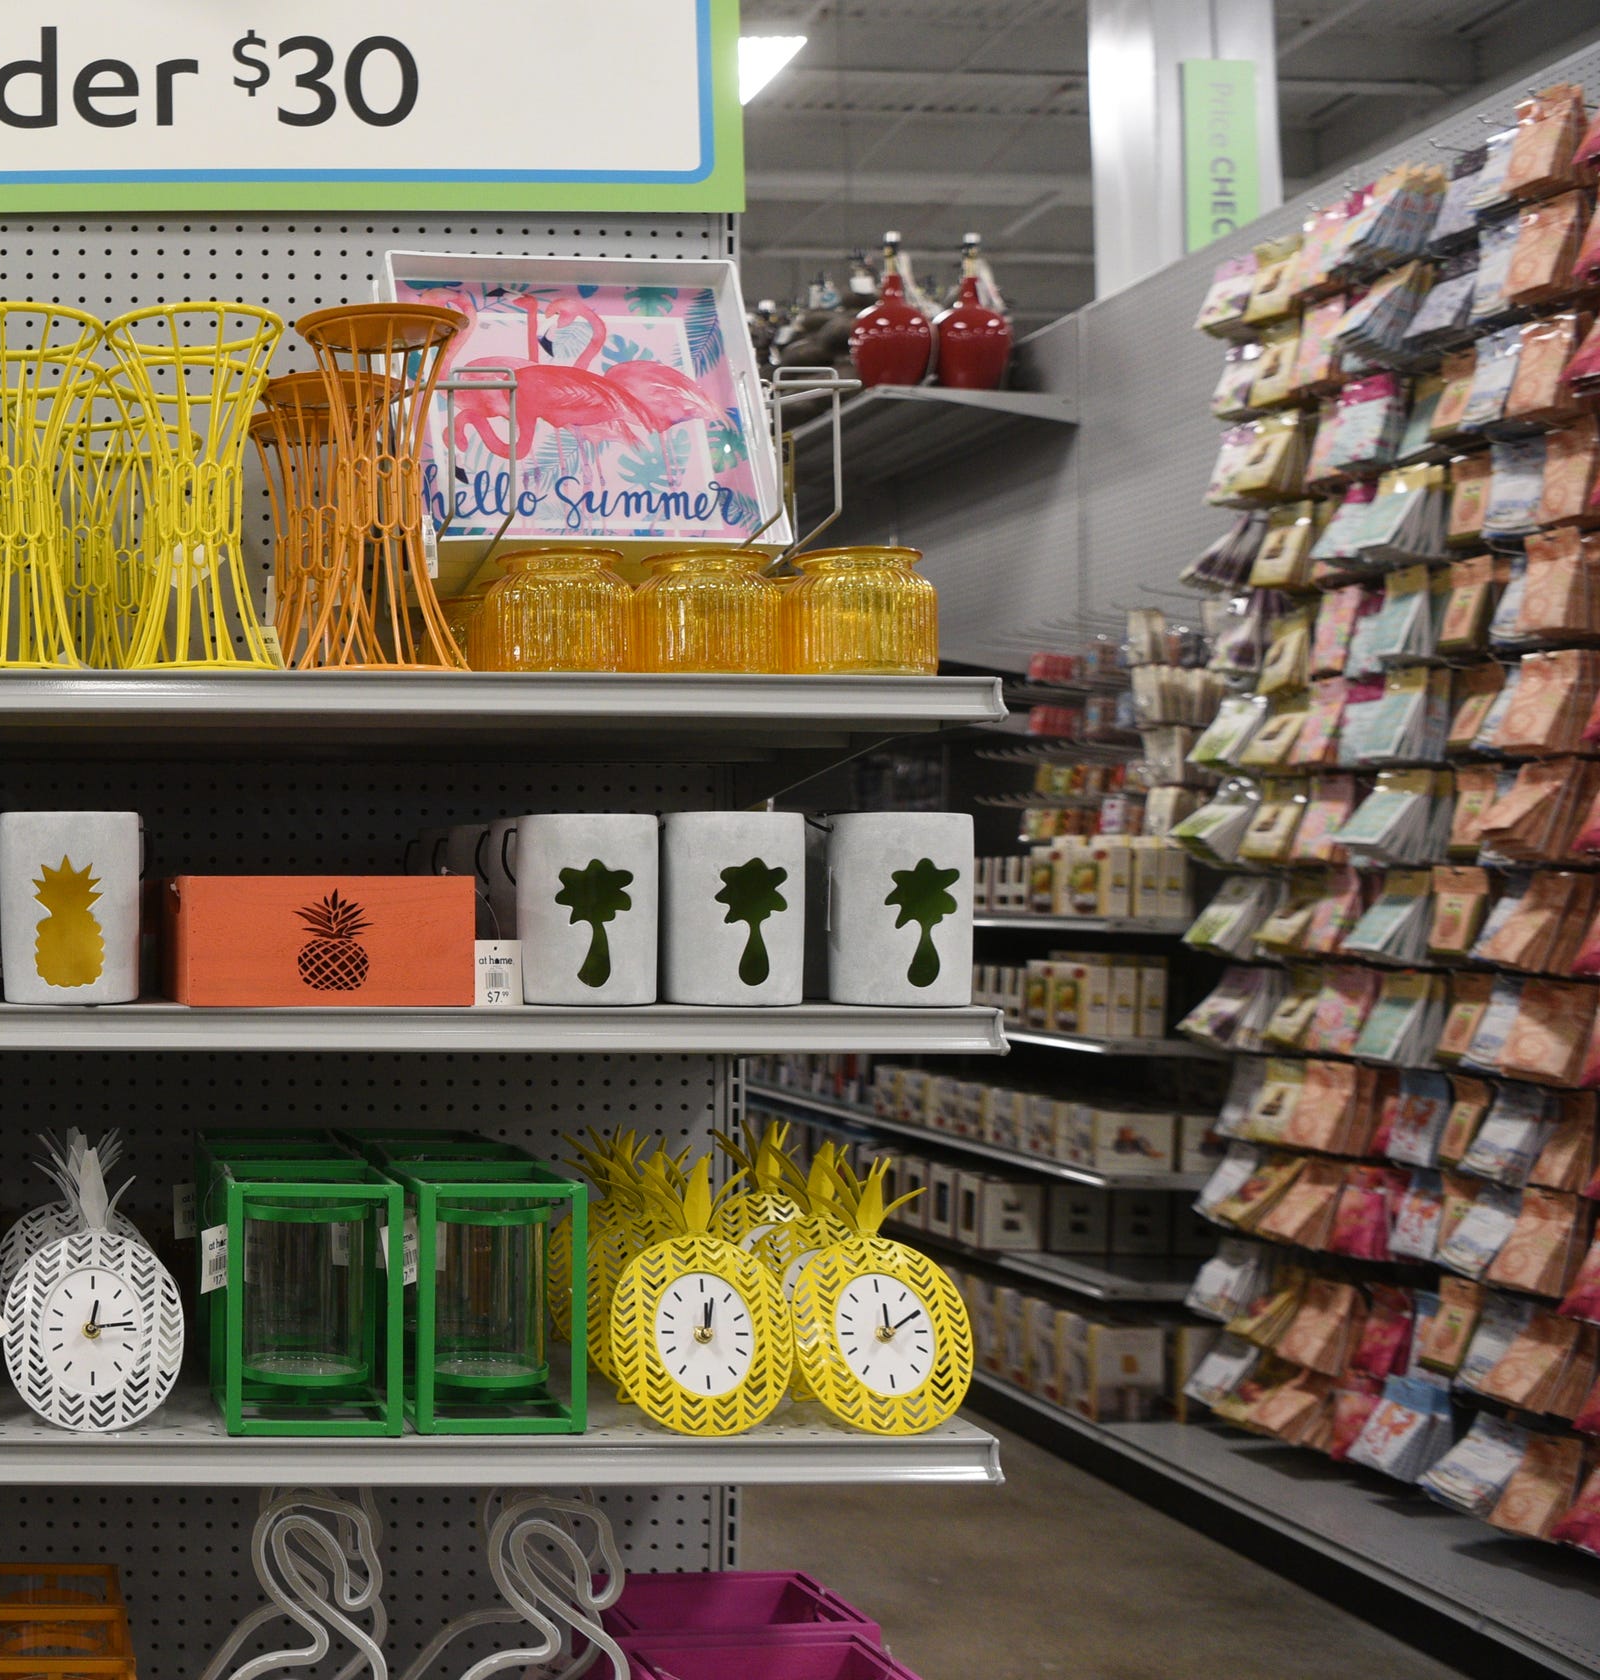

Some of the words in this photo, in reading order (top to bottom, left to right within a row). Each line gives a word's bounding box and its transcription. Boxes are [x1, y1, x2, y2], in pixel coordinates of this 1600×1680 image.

[232, 29, 419, 127] $30
[1211, 157, 1238, 235] CHEC
[422, 464, 547, 518] hello
